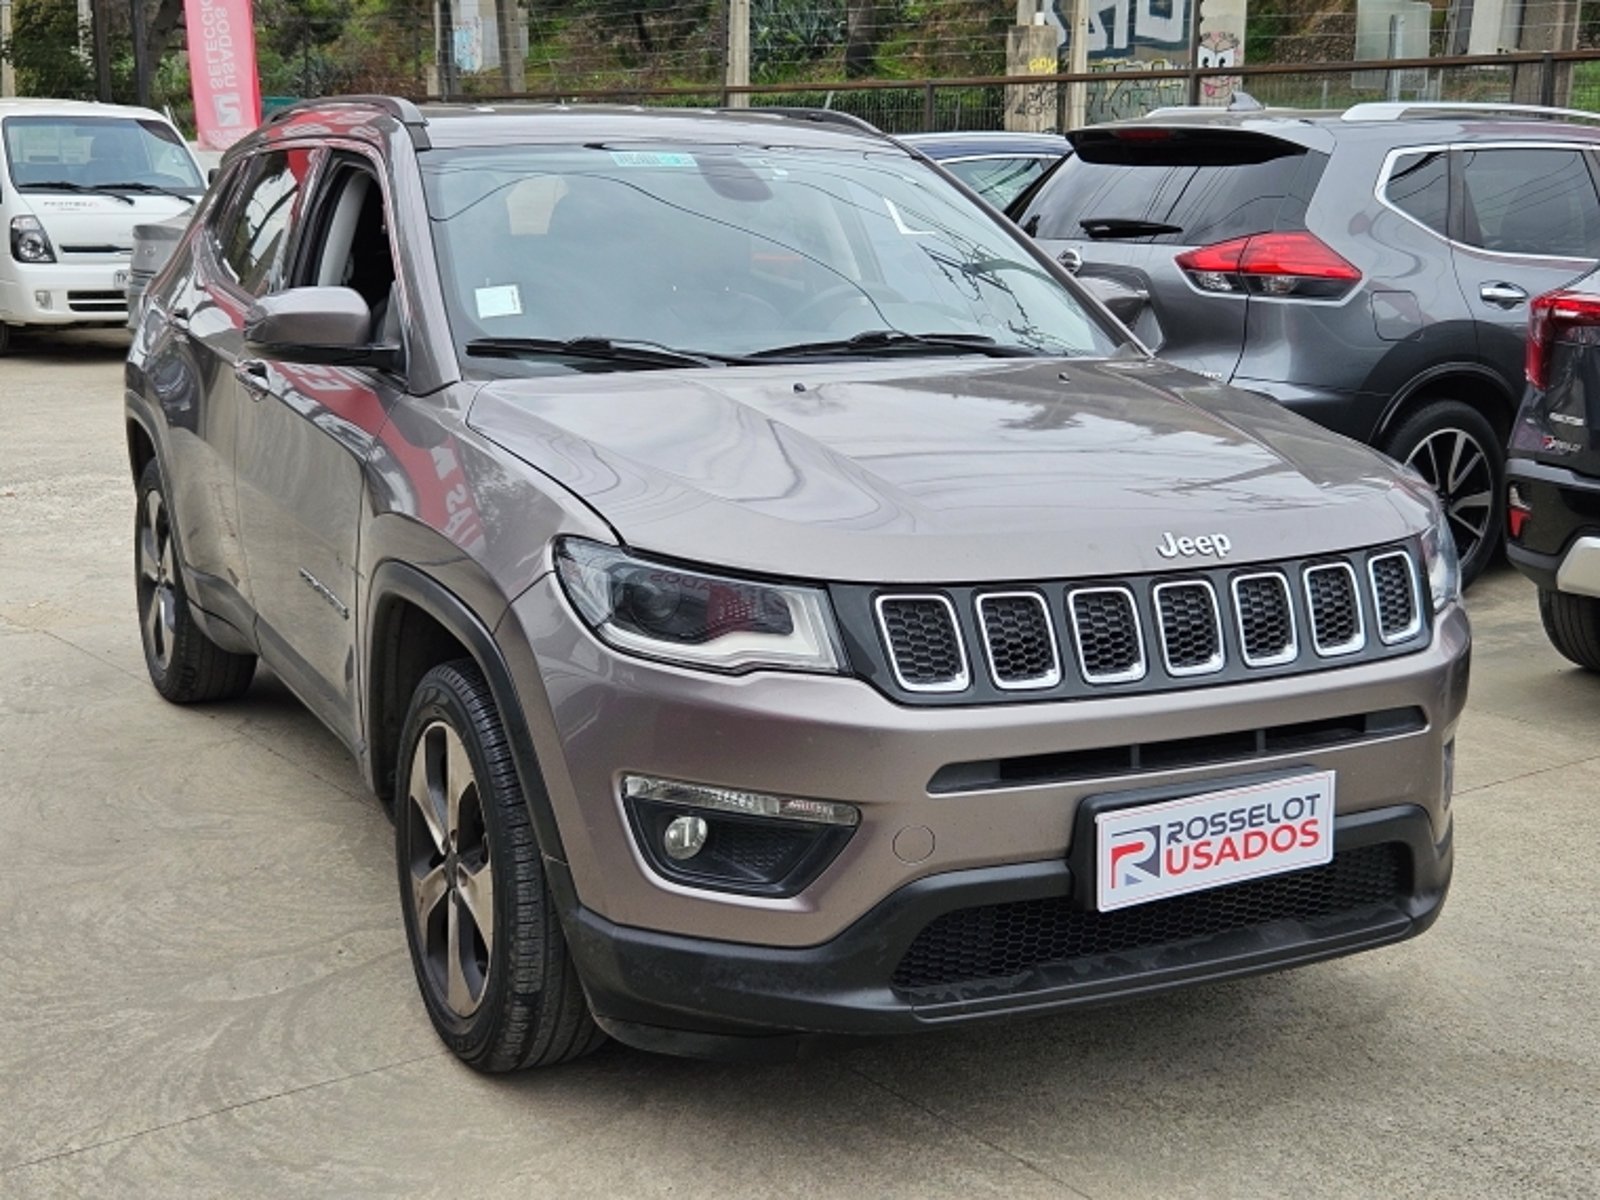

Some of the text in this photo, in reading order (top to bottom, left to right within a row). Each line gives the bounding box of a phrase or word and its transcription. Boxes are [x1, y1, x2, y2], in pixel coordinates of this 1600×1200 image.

[1156, 531, 1231, 559] Jeep
[1167, 794, 1321, 845] ROSSELOT
[1166, 819, 1320, 875] USADOS
